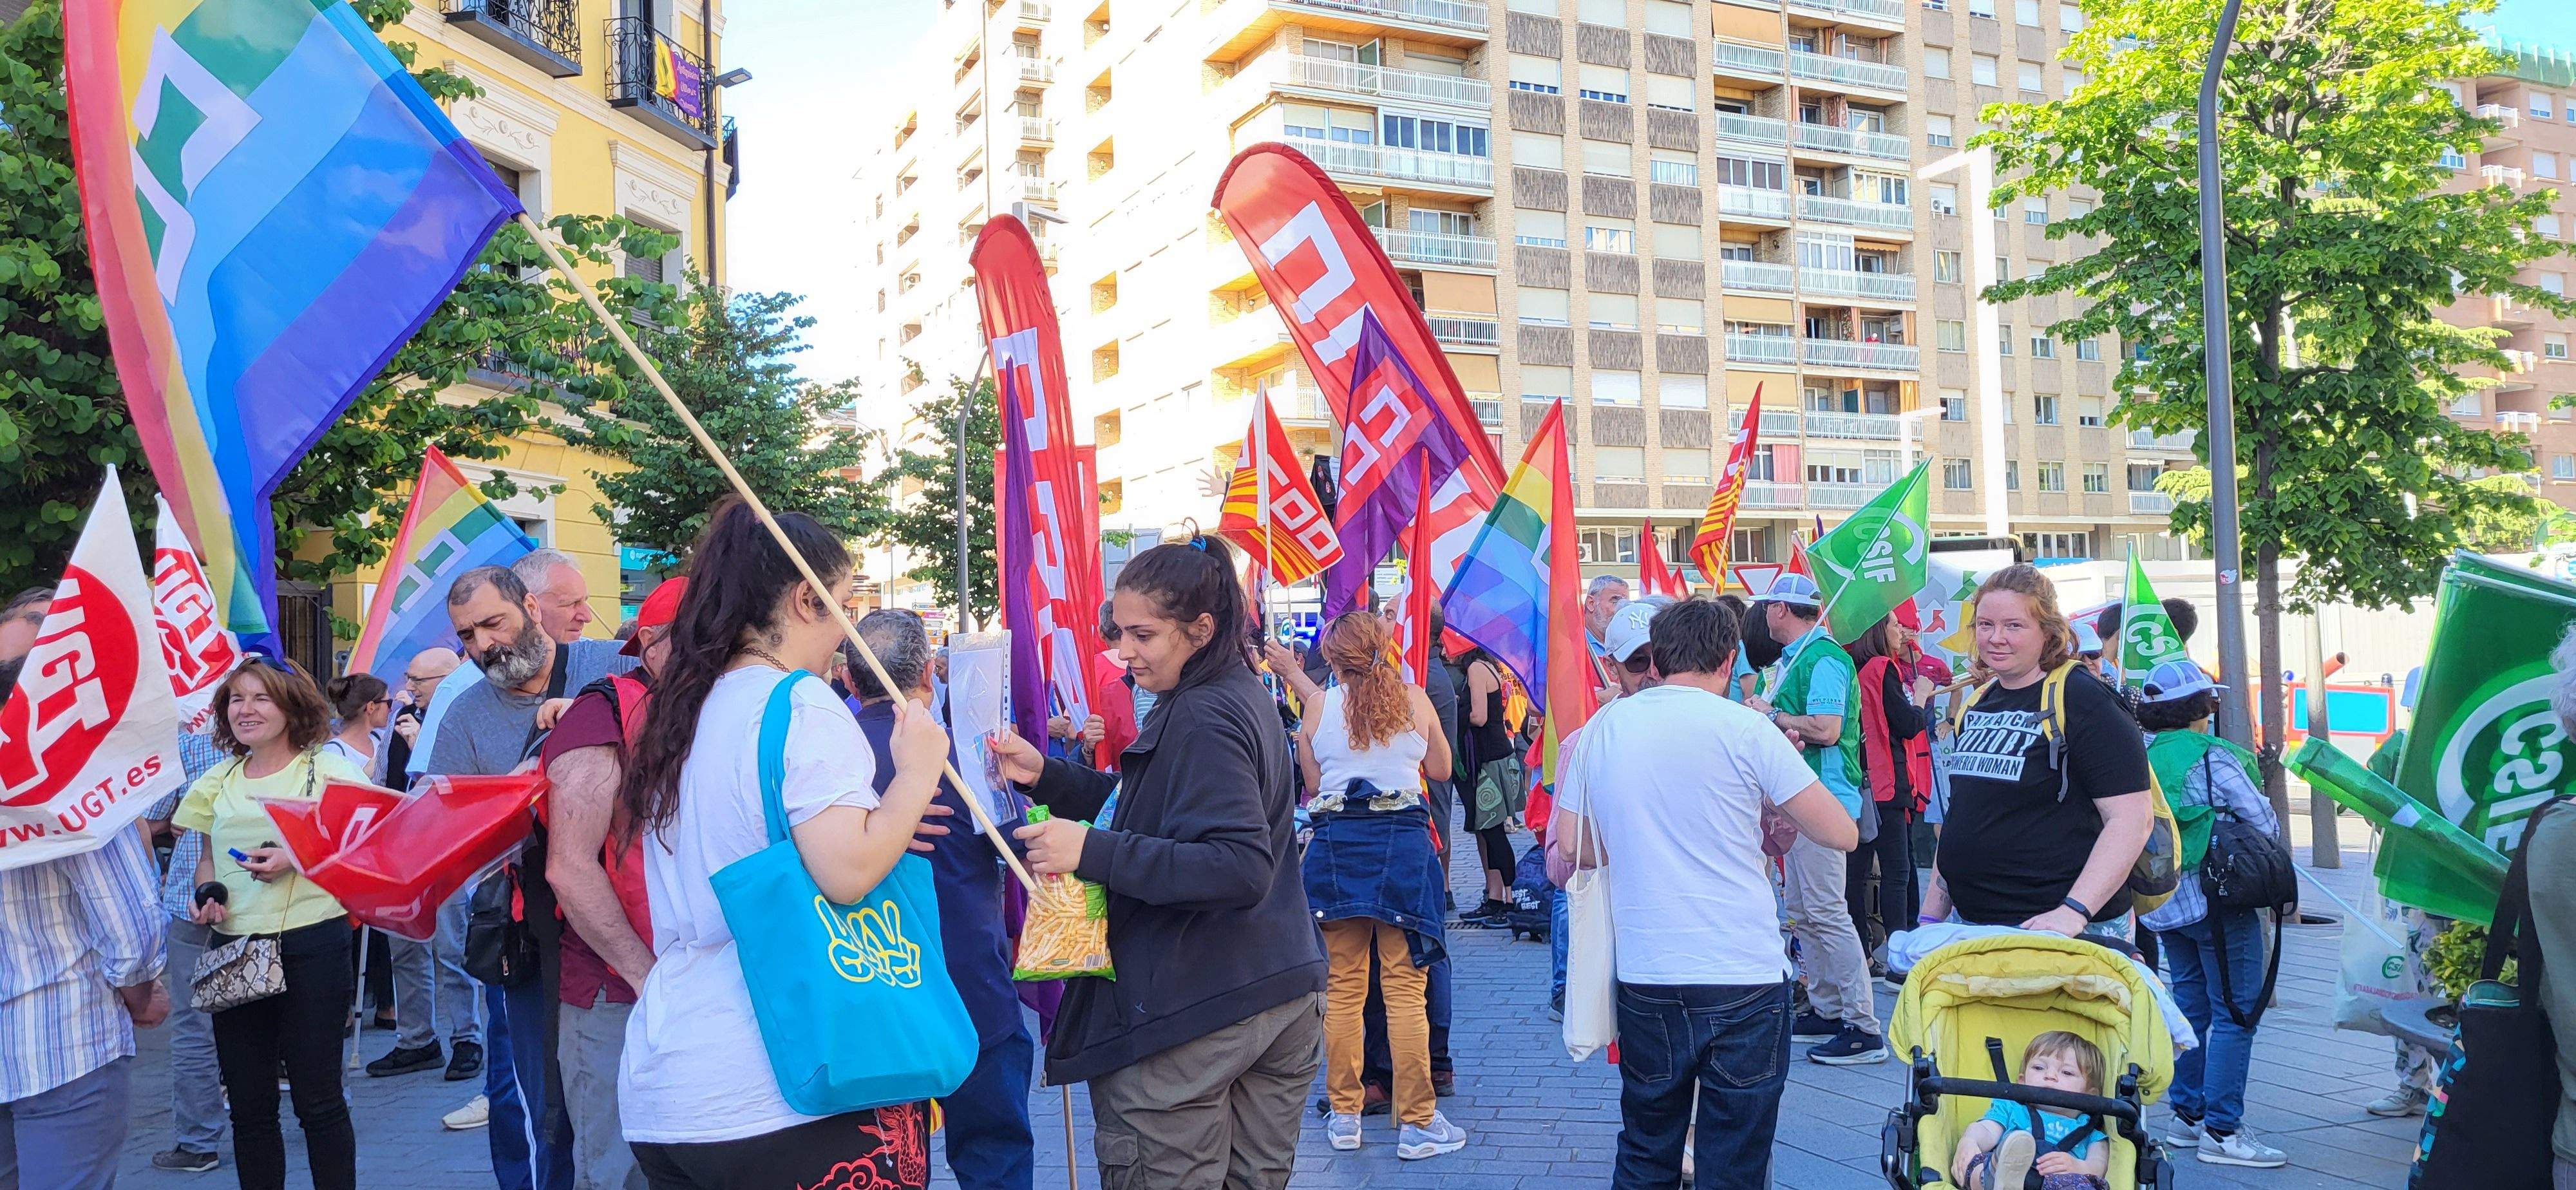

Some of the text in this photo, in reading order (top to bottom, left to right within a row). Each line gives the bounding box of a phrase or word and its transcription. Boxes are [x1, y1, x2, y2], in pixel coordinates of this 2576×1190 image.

[2126, 621, 2188, 666] CSI
[1976, 756, 2021, 777] WOMAN
[1521, 901, 1541, 911] BEST
